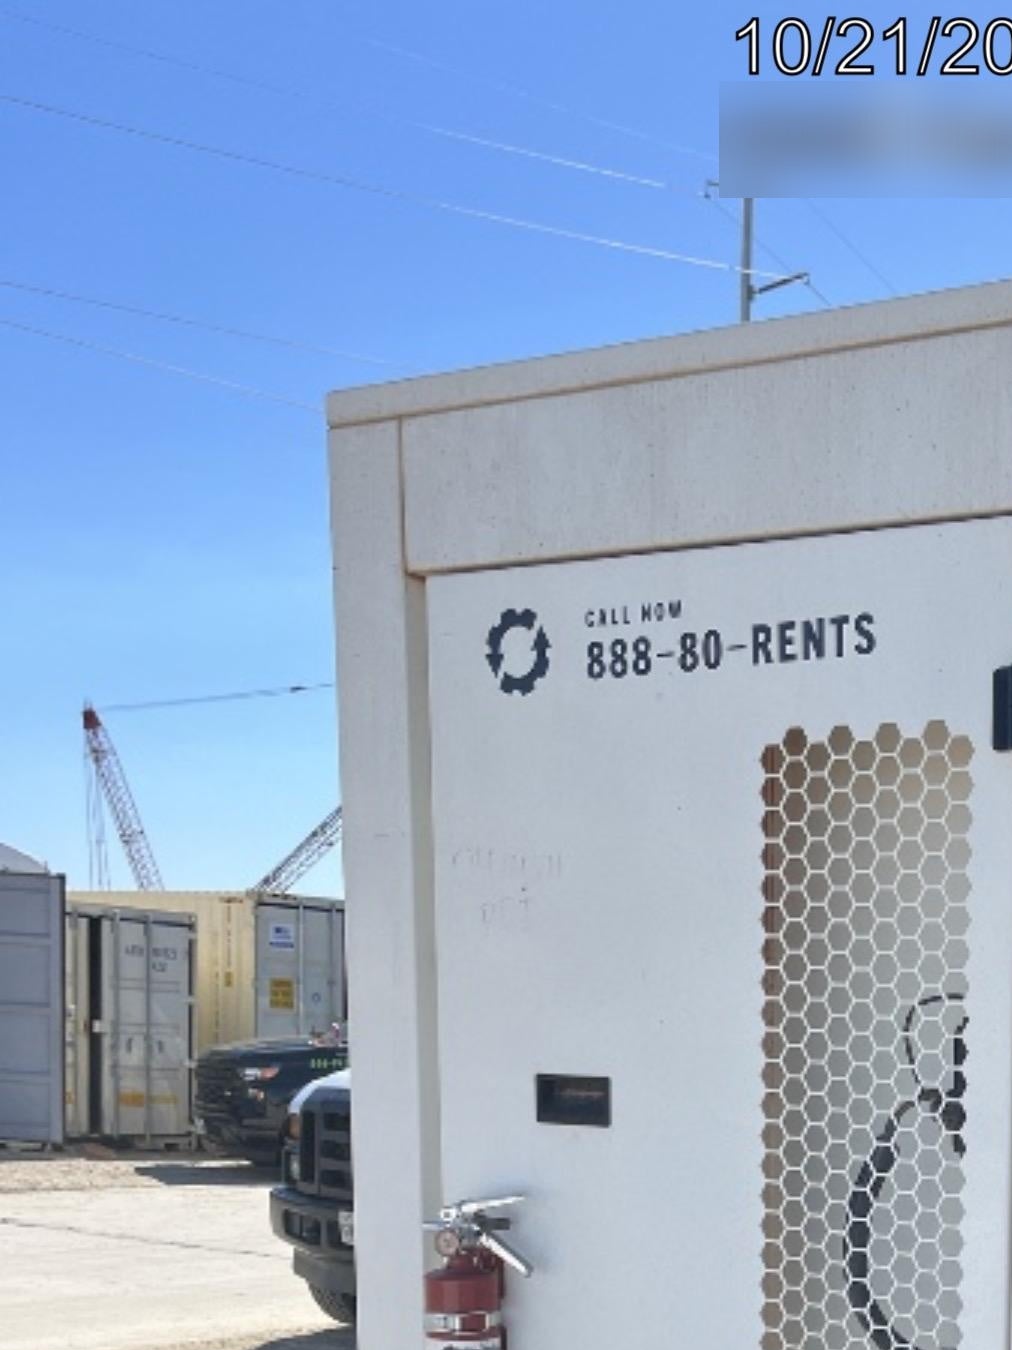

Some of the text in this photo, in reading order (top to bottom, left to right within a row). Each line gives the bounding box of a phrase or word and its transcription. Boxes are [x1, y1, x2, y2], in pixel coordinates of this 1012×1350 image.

[584, 600, 682, 627] CALL NOW
[586, 612, 877, 680] 888-80-RENTS
